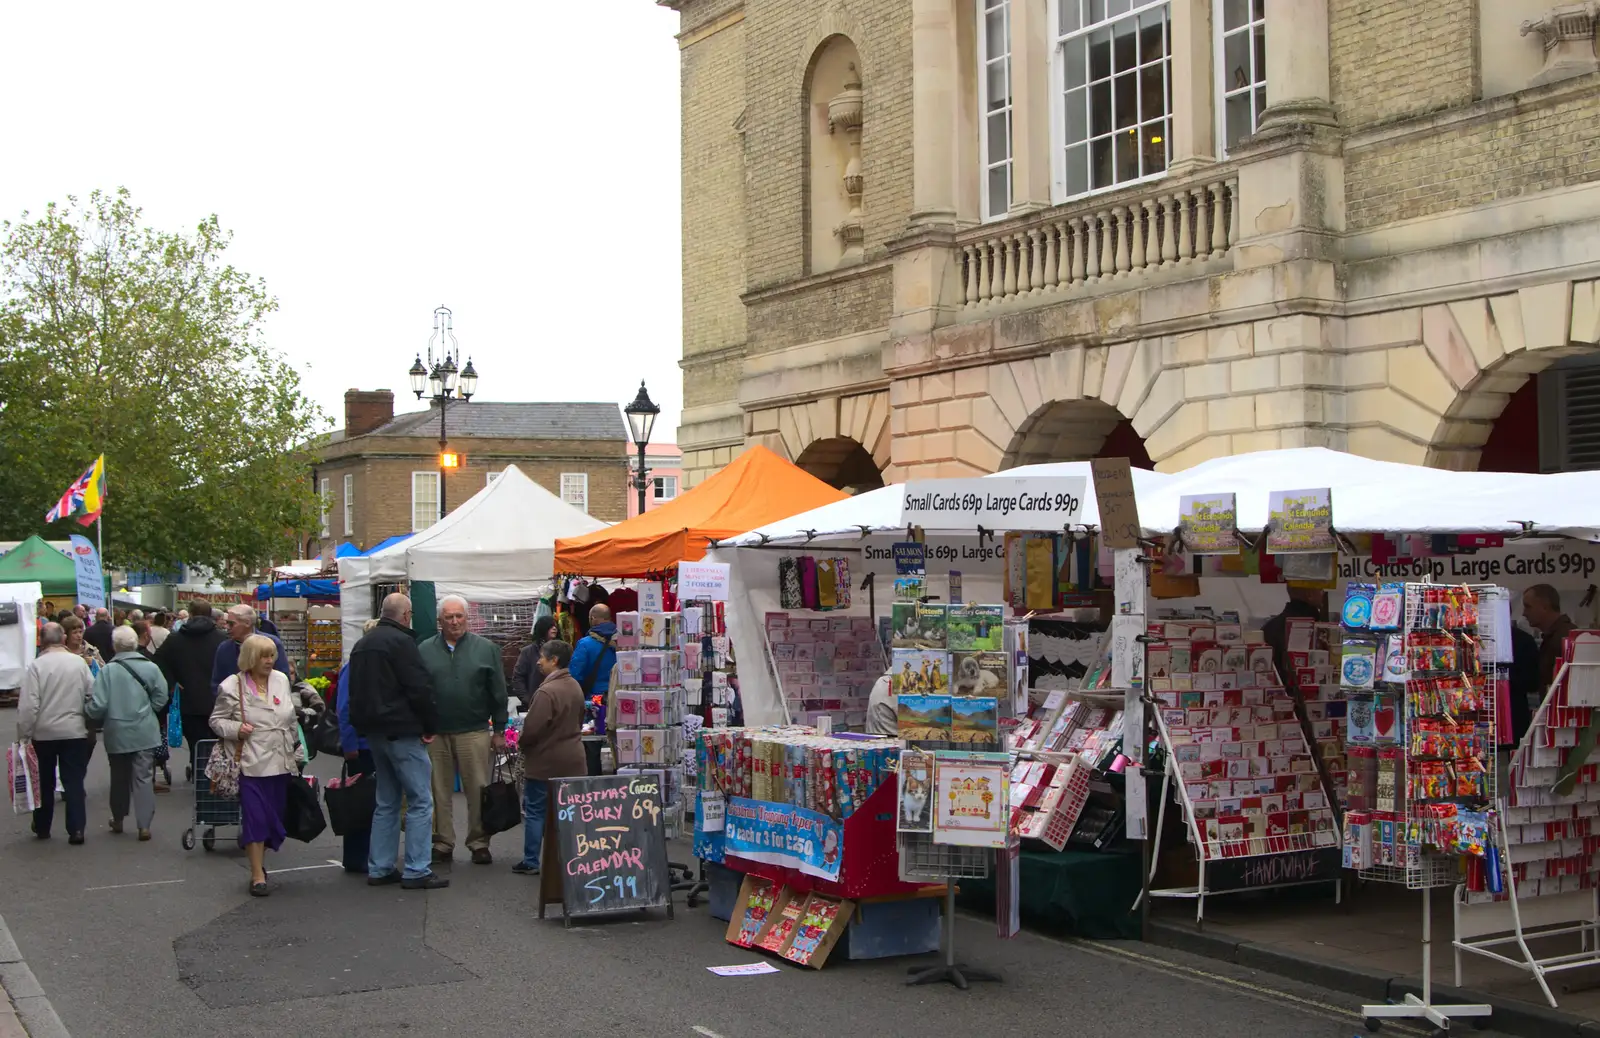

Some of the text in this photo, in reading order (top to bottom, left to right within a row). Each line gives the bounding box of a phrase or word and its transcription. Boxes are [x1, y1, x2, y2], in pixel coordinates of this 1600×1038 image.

[905, 492, 1078, 516] Small Cards 69p Large Cards 99p
[1203, 510, 1233, 521] Edmunds
[1296, 508, 1328, 518] Edmunds
[1284, 522, 1316, 531] Calendar
[865, 544, 894, 560] Smal
[936, 546, 958, 562] 69p
[962, 544, 993, 562] Large
[1451, 555, 1500, 580] Large
[1504, 552, 1556, 577] Cards
[1559, 553, 1596, 578] 99p
[558, 779, 658, 806] CHRISTMAS CARDS
[558, 799, 660, 826] OF BURY 69p
[759, 806, 789, 828] Wrapping
[792, 812, 814, 832] Paper
[576, 833, 622, 856] BURY
[737, 828, 755, 843] each
[763, 831, 770, 846] 3
[567, 848, 644, 876] CALENDAR
[1240, 853, 1320, 885] HANDMADE
